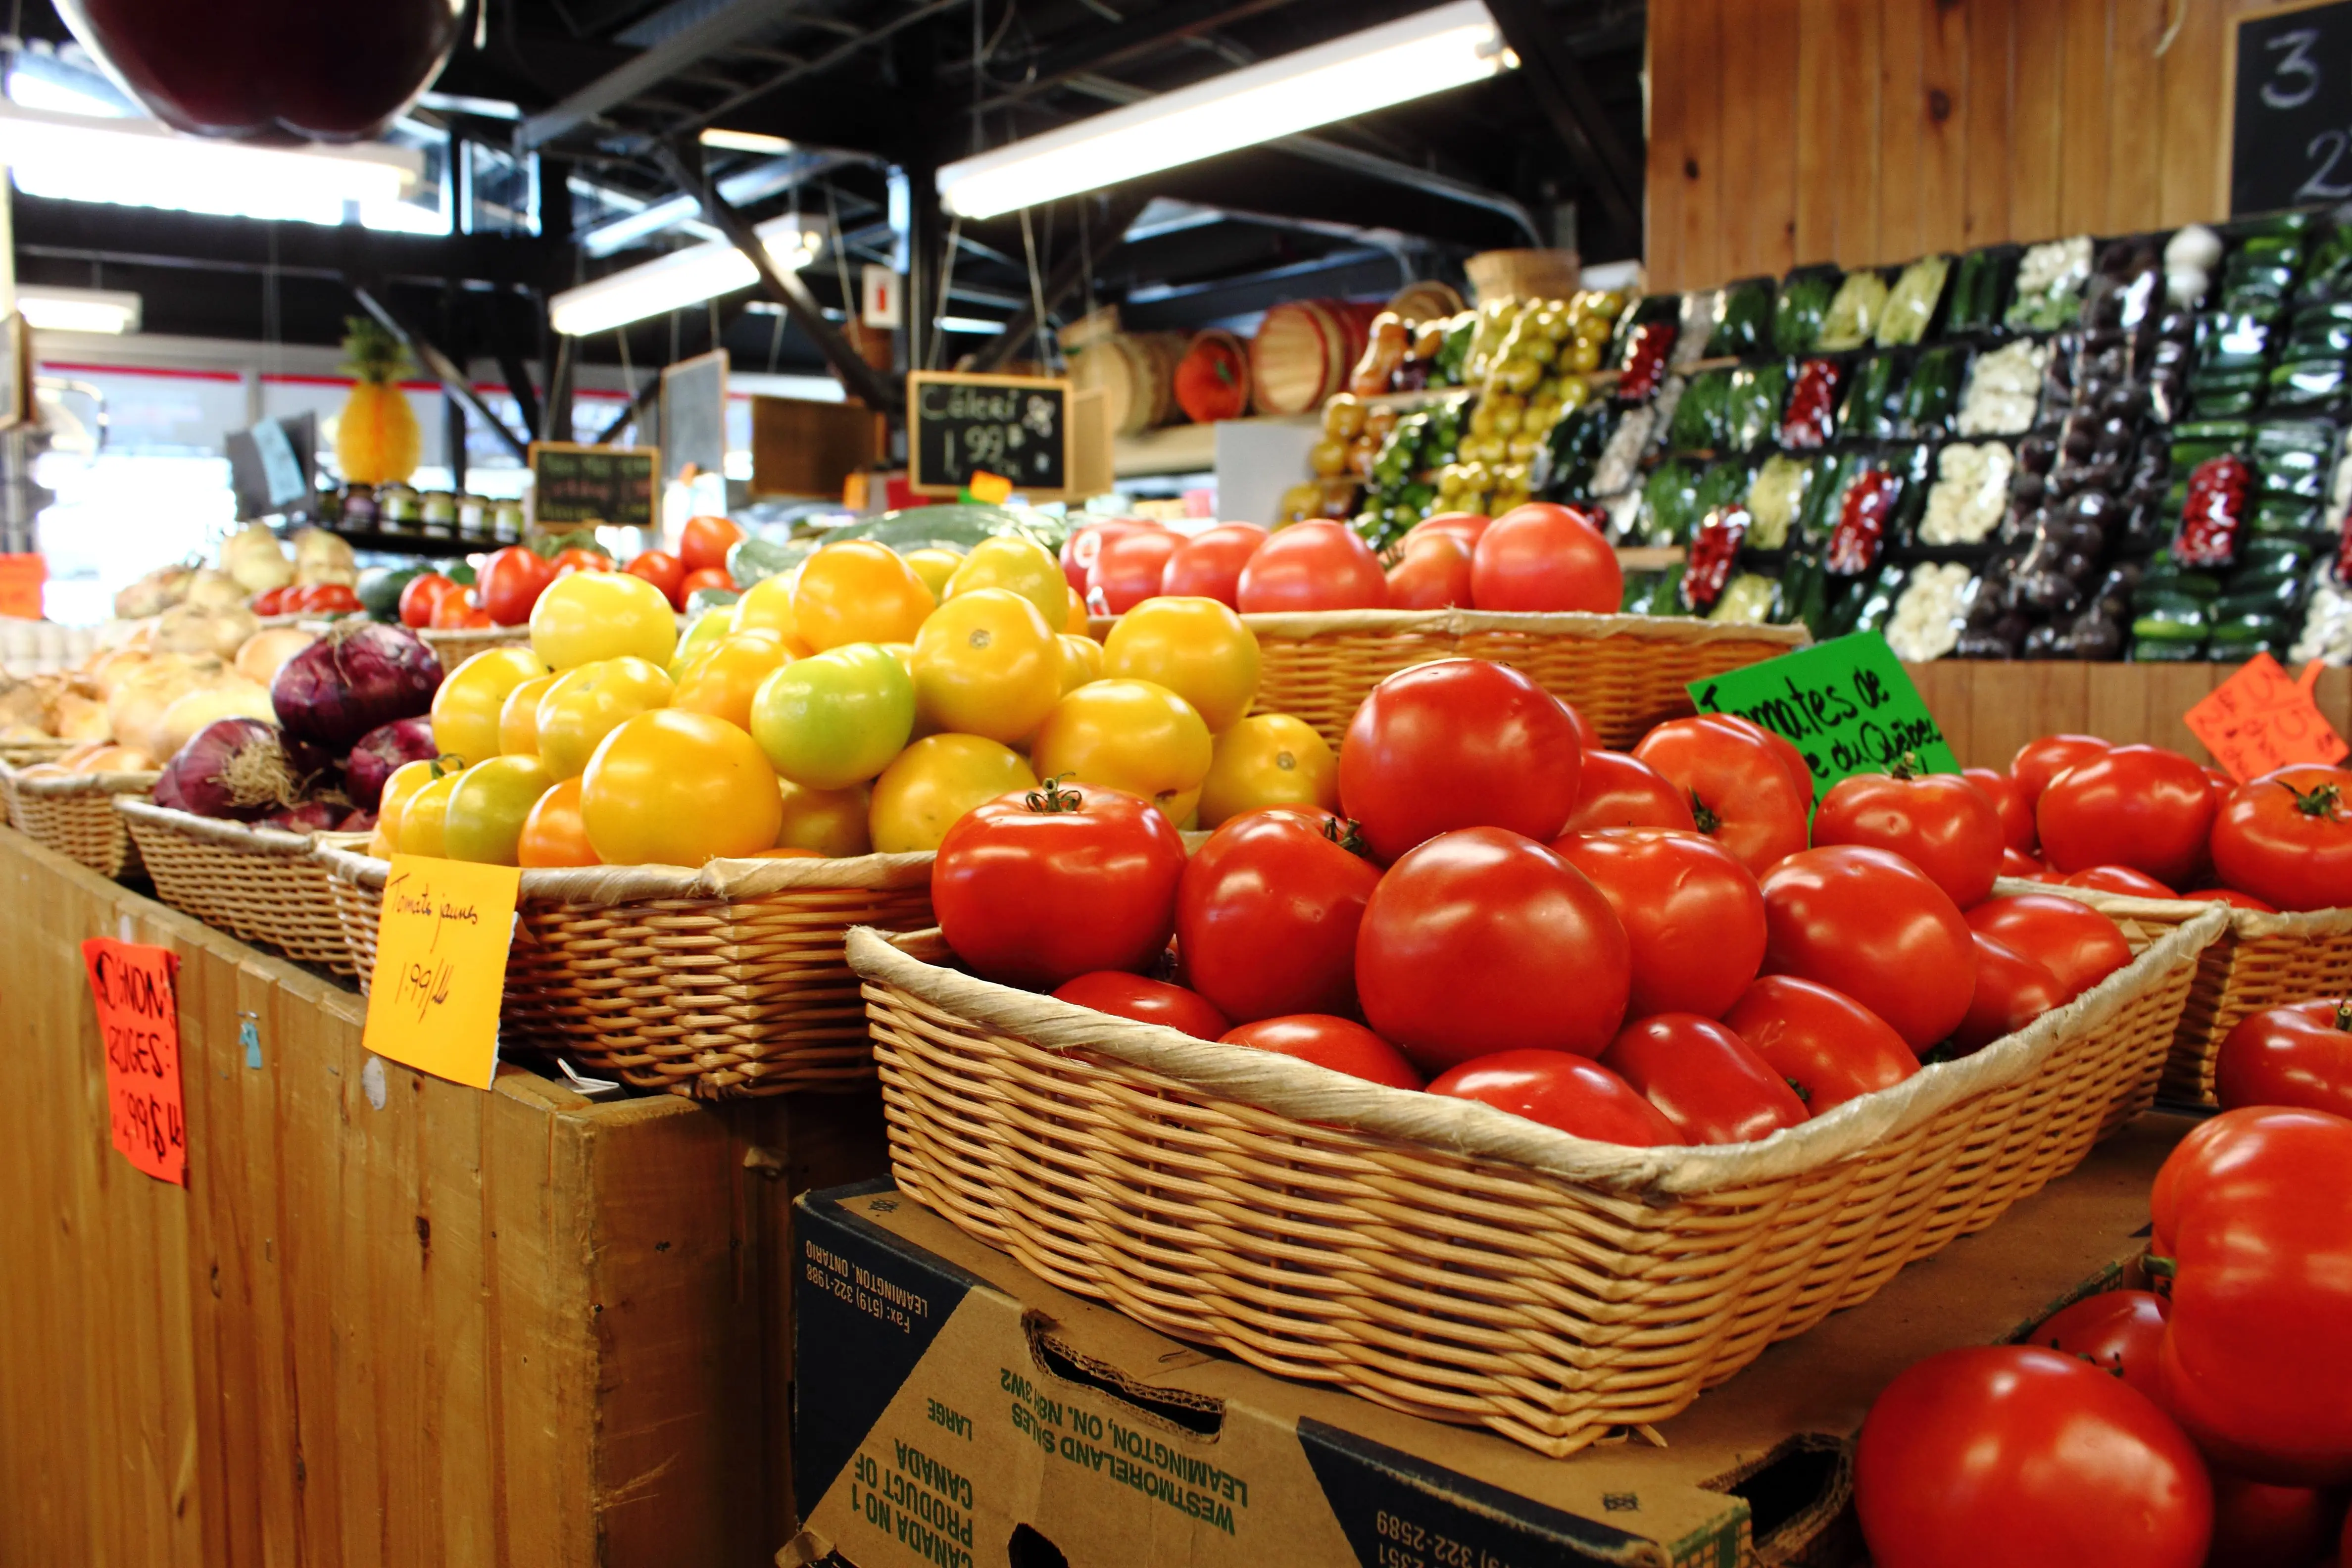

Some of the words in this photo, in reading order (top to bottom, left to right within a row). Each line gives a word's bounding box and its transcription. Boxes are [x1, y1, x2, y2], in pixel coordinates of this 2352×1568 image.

[2260, 29, 2320, 109] 3
[806, 1240, 848, 1277] ONTARIO
[806, 1263, 853, 1304] 322-1988
[852, 1262, 928, 1318] LEAMINGTON,
[857, 1286, 883, 1320] (519)
[886, 1305, 910, 1334] Fax:
[1000, 1367, 1032, 1404] 3W2
[927, 1398, 972, 1442] LARGE
[1011, 1402, 1056, 1454] SALES
[1068, 1406, 1103, 1441] ON.
[854, 1453, 878, 1489] OF
[894, 1438, 973, 1510] CANADA
[1108, 1418, 1248, 1509] LEAMINGTON,
[851, 1483, 861, 1512] 1
[1060, 1436, 1235, 1536] WESTMORELAND
[866, 1492, 890, 1534] NO
[882, 1469, 973, 1550] PRODUCT
[1376, 1510, 1473, 1568] 322-2589
